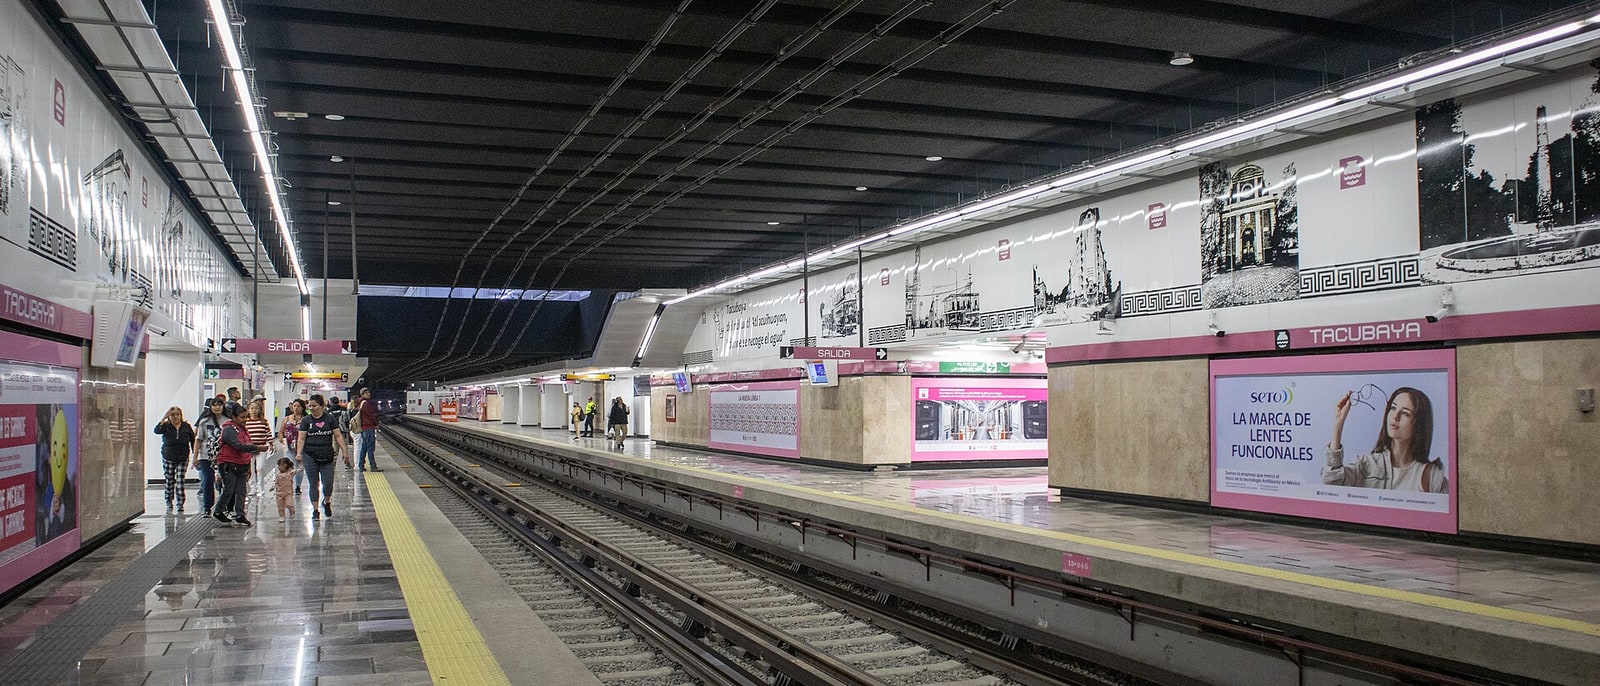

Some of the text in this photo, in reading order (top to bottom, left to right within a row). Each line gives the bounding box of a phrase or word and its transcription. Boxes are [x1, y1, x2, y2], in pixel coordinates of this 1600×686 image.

[4, 290, 55, 325] TACUBAYA
[726, 302, 747, 314] Tacubaya
[1309, 322, 1421, 344] TACUBAYA
[268, 342, 310, 352] SALIDA
[818, 350, 851, 358] SALIDA
[1232, 412, 1312, 426] LA MARCA DE
[1250, 429, 1292, 443] LENTES
[1232, 444, 1313, 461] FUNCIONALES
